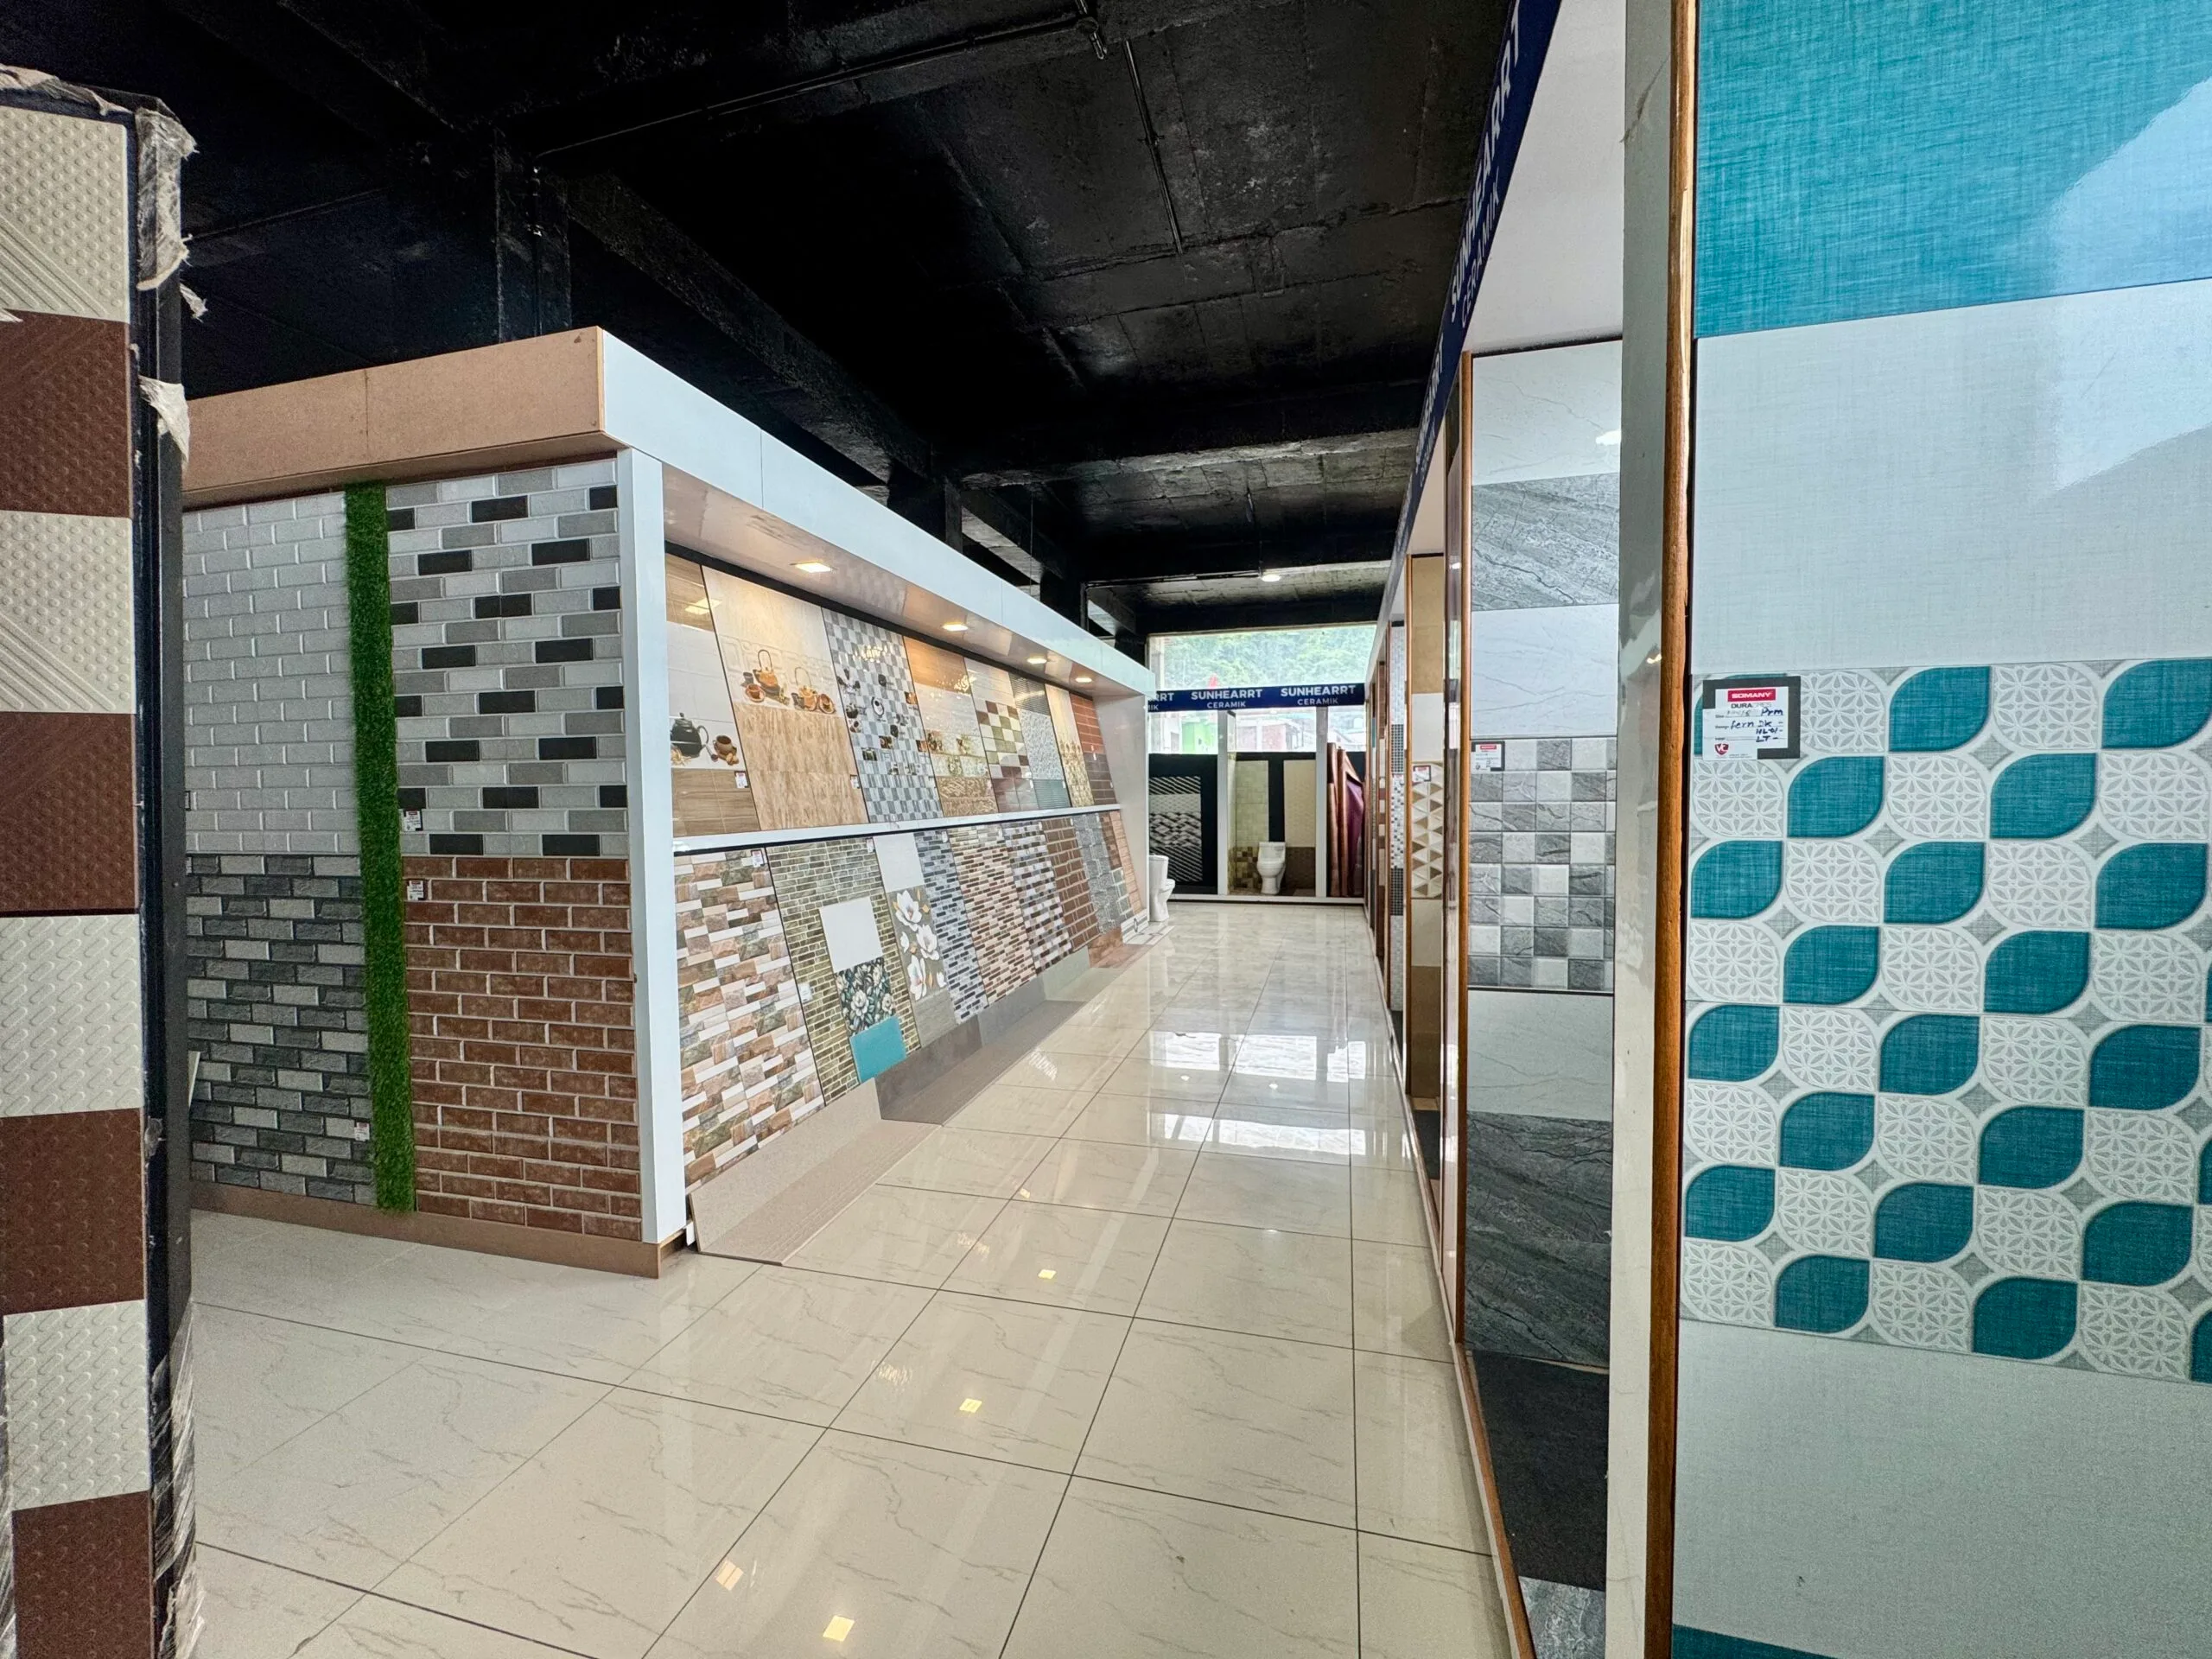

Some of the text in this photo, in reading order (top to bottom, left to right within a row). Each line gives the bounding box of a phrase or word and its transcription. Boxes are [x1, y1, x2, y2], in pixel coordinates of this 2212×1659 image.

[1451, 0, 1520, 323] SUNHEARRT
[1462, 166, 1500, 328] CERAMIK
[1191, 689, 1263, 701] SUNHEARRT
[1280, 684, 1357, 697] SUNHEARRT
[1206, 701, 1247, 709] CERAMIK
[1297, 697, 1338, 706] CERAMIK
